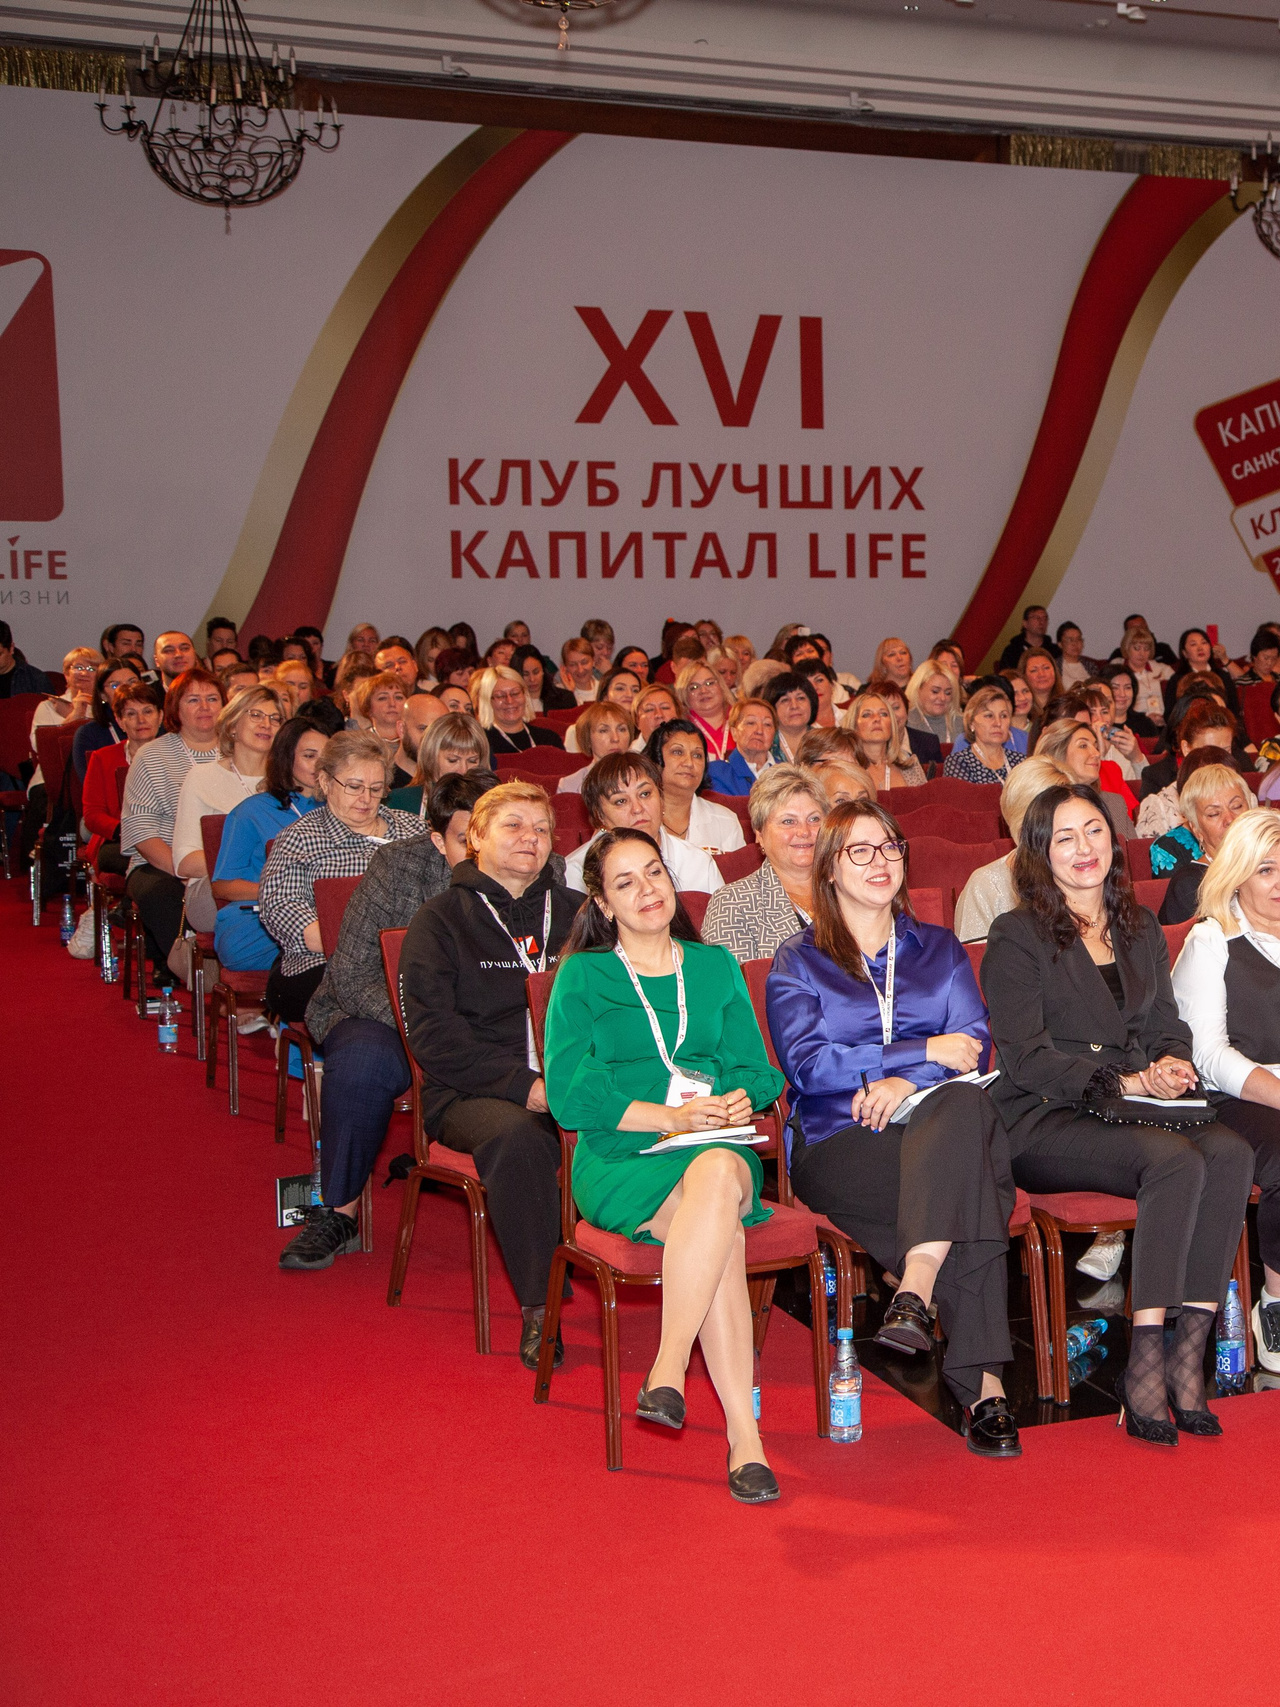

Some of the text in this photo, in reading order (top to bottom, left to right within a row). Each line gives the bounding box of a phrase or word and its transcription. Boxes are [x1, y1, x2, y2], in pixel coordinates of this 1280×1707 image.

[574, 306, 825, 430] XVI
[448, 458, 926, 511] КЛУБ ЛУЧШИХ
[450, 530, 927, 580] КАПИТАЛ LIFE
